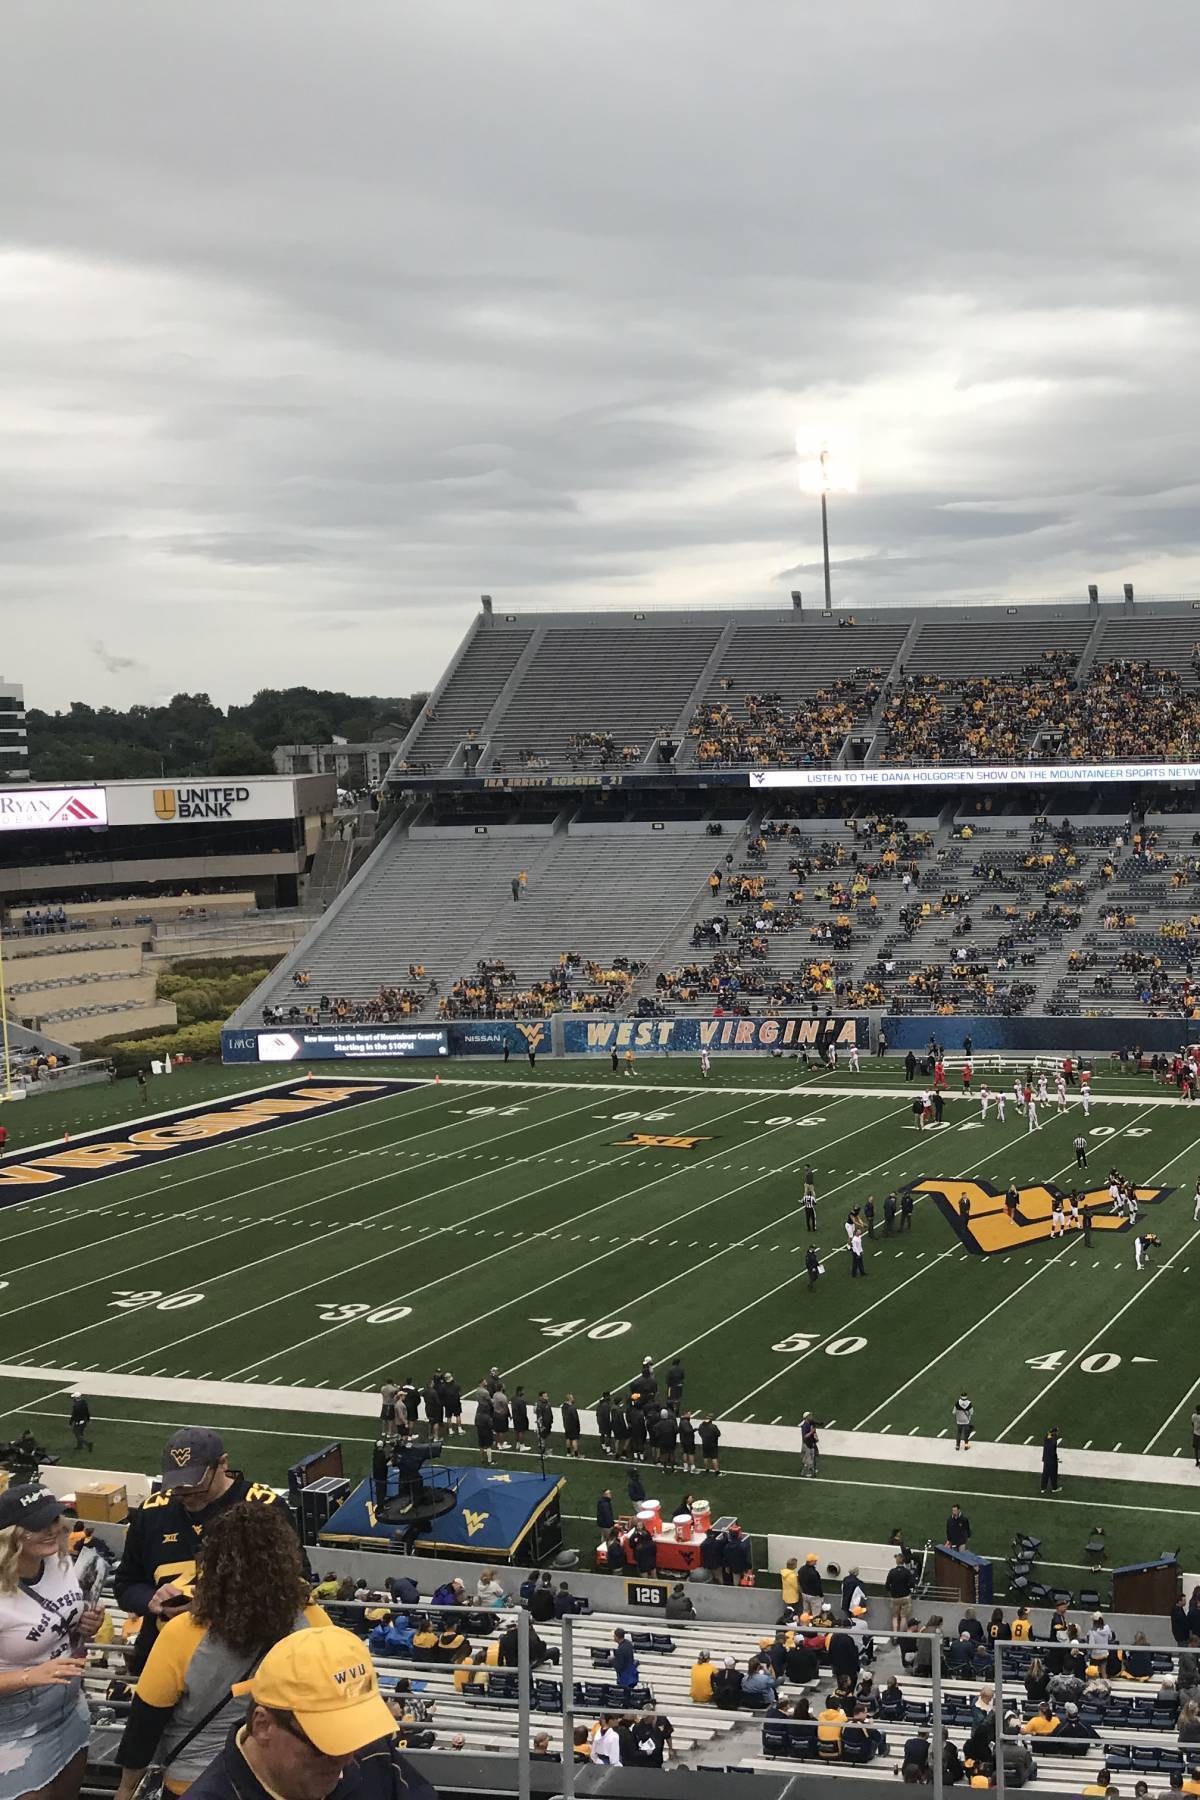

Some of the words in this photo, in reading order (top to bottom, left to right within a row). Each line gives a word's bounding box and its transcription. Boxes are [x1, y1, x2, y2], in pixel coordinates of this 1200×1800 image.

[609, 776, 623, 785] 21
[808, 774, 841, 782] LISTEN
[861, 773, 878, 781] THE
[882, 773, 910, 781] DANA
[913, 772, 973, 780] HOLGORSEN
[977, 771, 1008, 779] SHOW
[1011, 771, 1025, 779] ON
[1030, 771, 1046, 779] THE
[1050, 769, 1123, 778] MOUNTAINEER
[1126, 768, 1165, 777] SPORTS
[177, 788, 249, 803] UNITED
[1, 797, 50, 814] RYAN
[178, 802, 232, 818] BANK
[464, 1034, 500, 1042] NISSAN
[586, 1021, 675, 1046] WEST
[228, 1038, 255, 1049] IMG
[334, 1043, 365, 1052] Starting
[366, 1043, 373, 1051] in
[374, 1042, 388, 1051] the
[0, 1085, 390, 1185] VIRGINIA
[1089, 1126, 1153, 1138] 50
[107, 1290, 205, 1311] 20
[317, 1303, 413, 1325] 30
[538, 1318, 632, 1340] 40
[770, 1333, 868, 1356] 50
[1024, 1349, 1122, 1373] 40
[636, 1587, 660, 1604] 126
[25, 1613, 51, 1642] West
[992, 1625, 999, 1638] 8
[1015, 1624, 1023, 1637] 8
[334, 1664, 366, 1684] WVU
